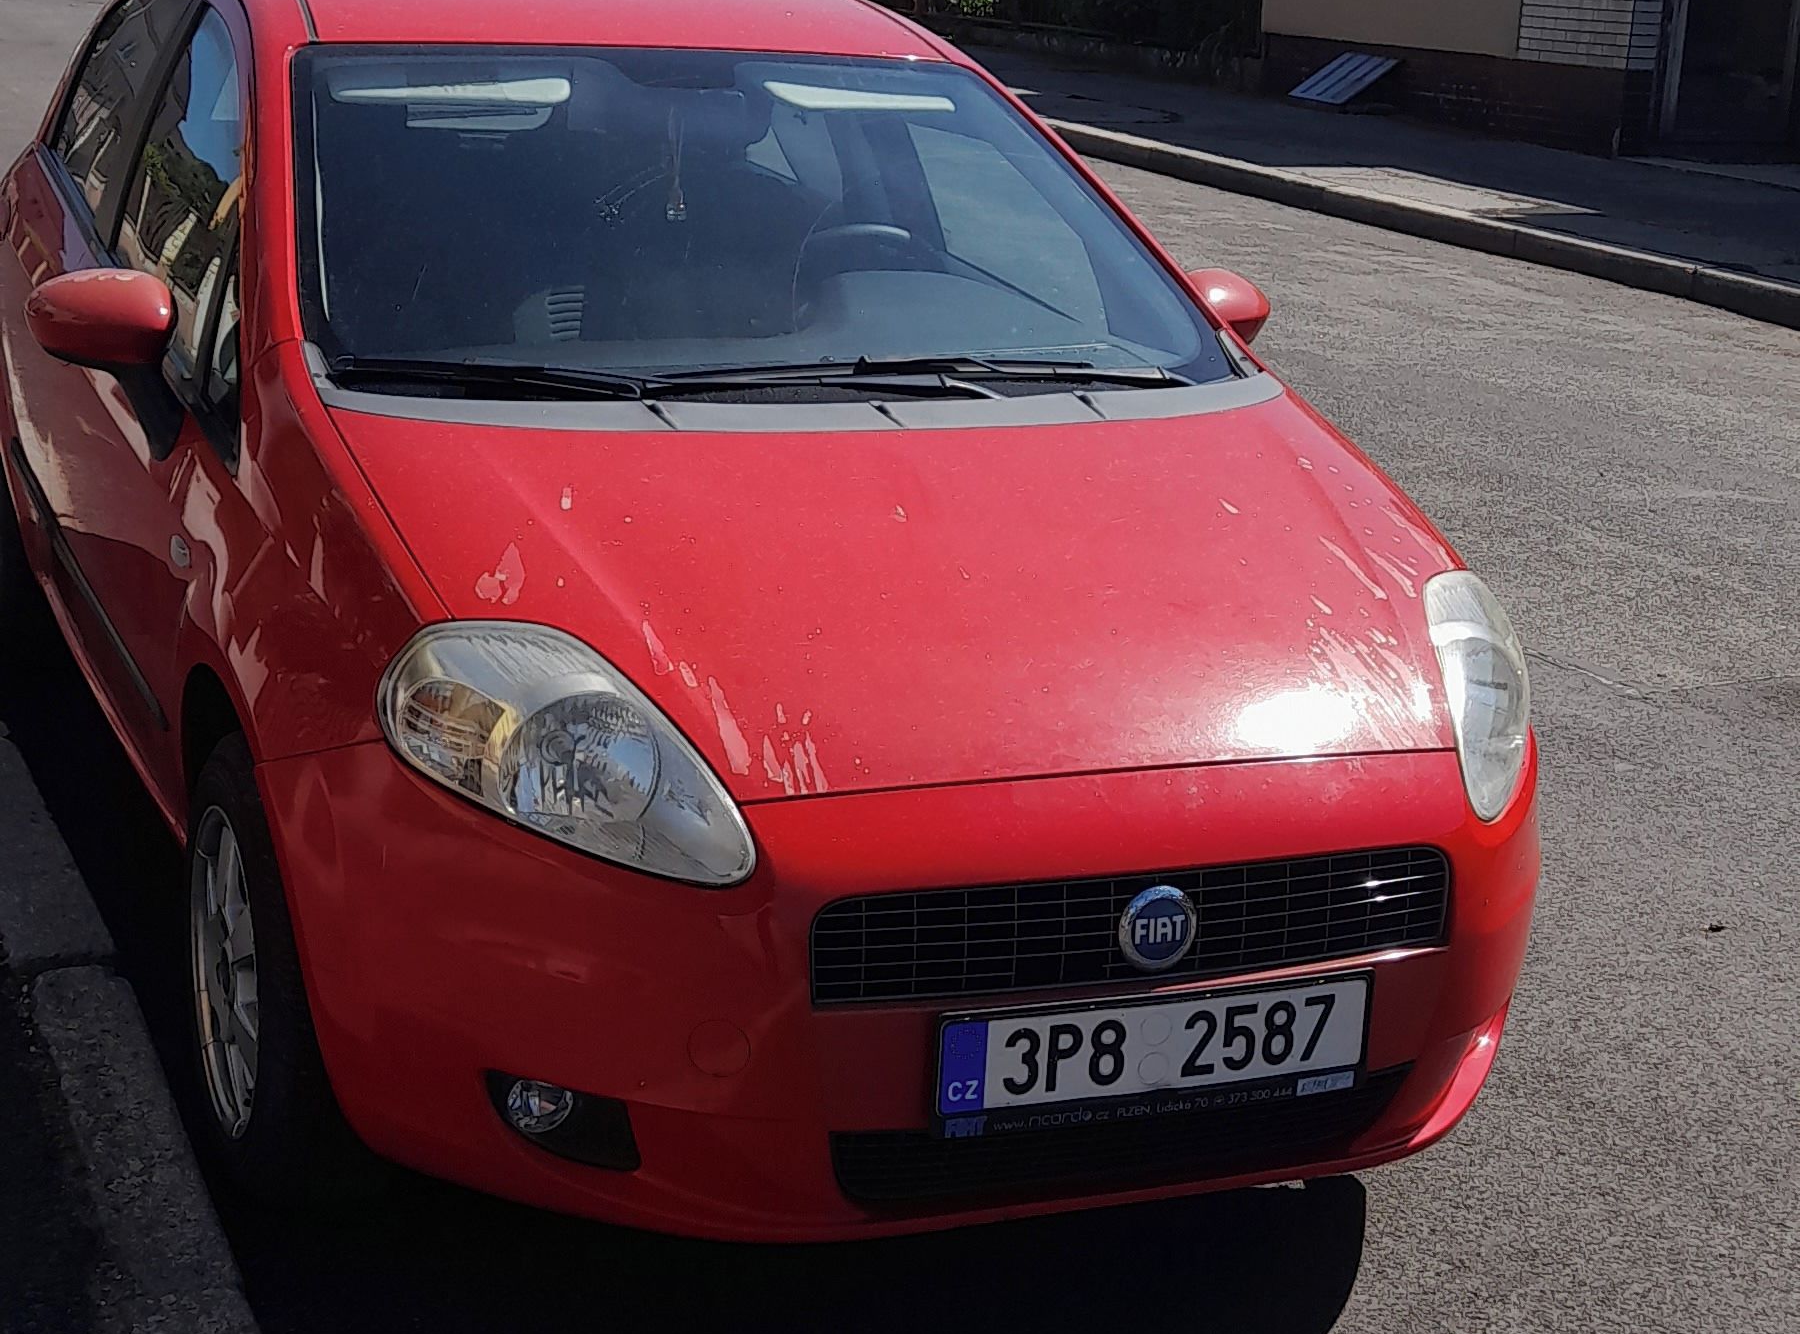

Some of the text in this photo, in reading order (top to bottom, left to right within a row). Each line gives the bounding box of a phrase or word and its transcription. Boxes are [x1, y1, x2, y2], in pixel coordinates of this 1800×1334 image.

[1134, 914, 1186, 945] FIAT
[1002, 993, 1336, 1096] 3P8 2587
[948, 1080, 979, 1102] CZ
